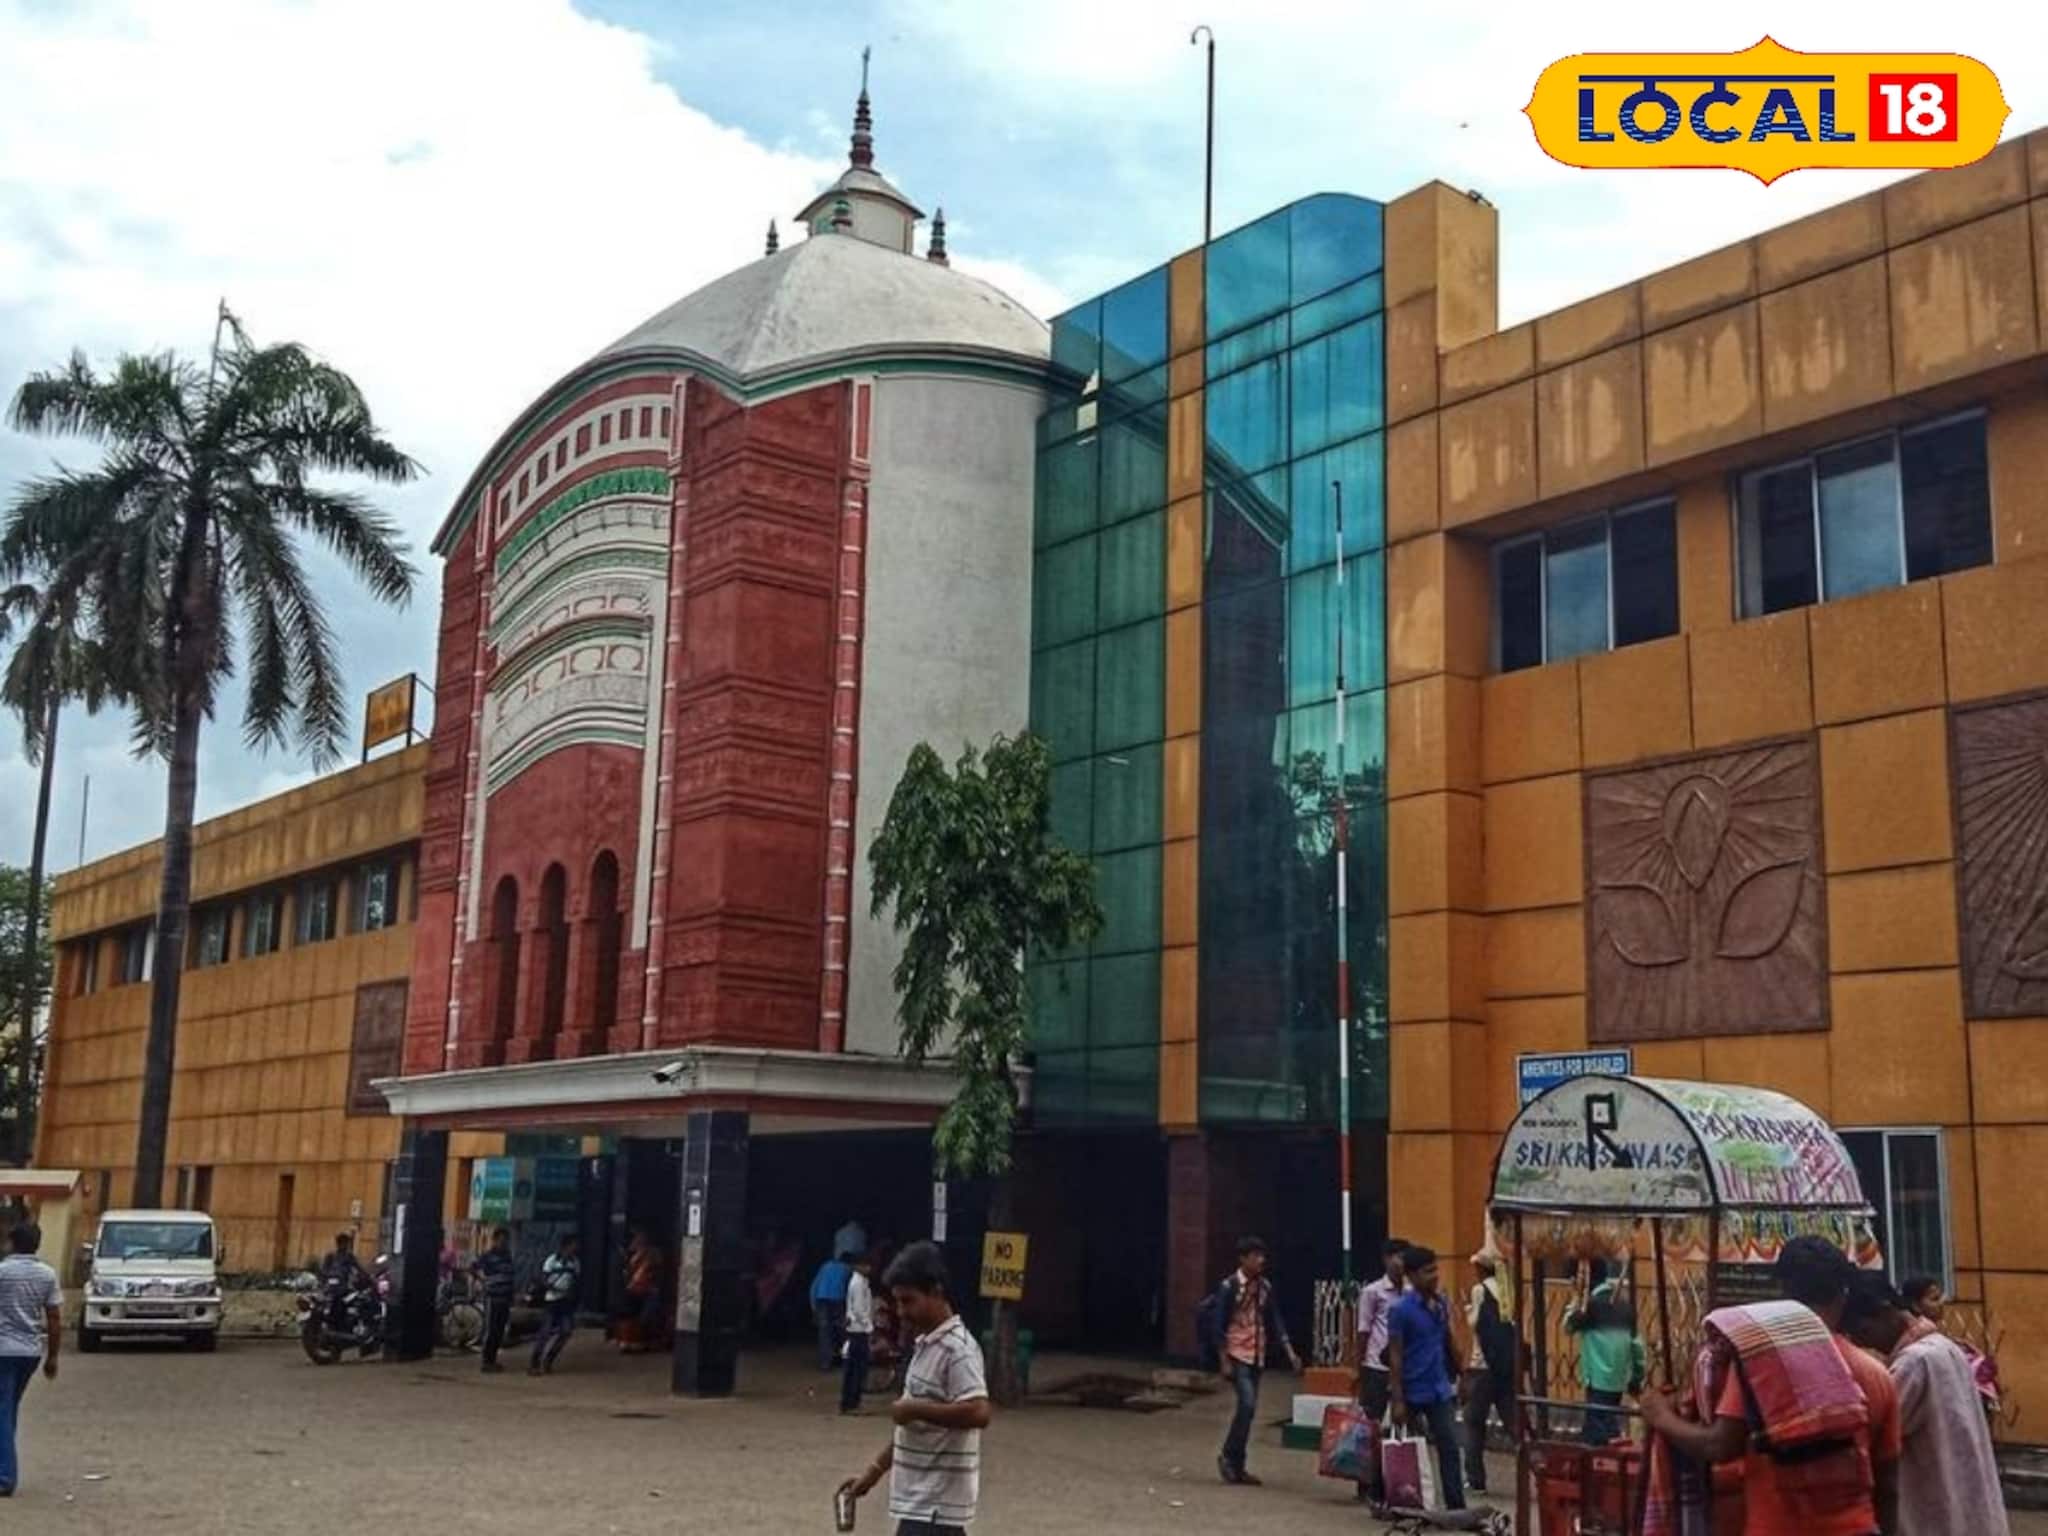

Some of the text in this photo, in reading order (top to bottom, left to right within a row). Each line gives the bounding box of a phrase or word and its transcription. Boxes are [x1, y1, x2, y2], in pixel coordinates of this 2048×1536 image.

[1565, 1058, 1582, 1075] FOR
[1583, 1056, 1625, 1074] DISABLED
[1515, 1140, 1687, 1169] SRI KRSNA'S
[994, 1242, 1014, 1260] NO
[983, 1265, 1025, 1289] PARKING
